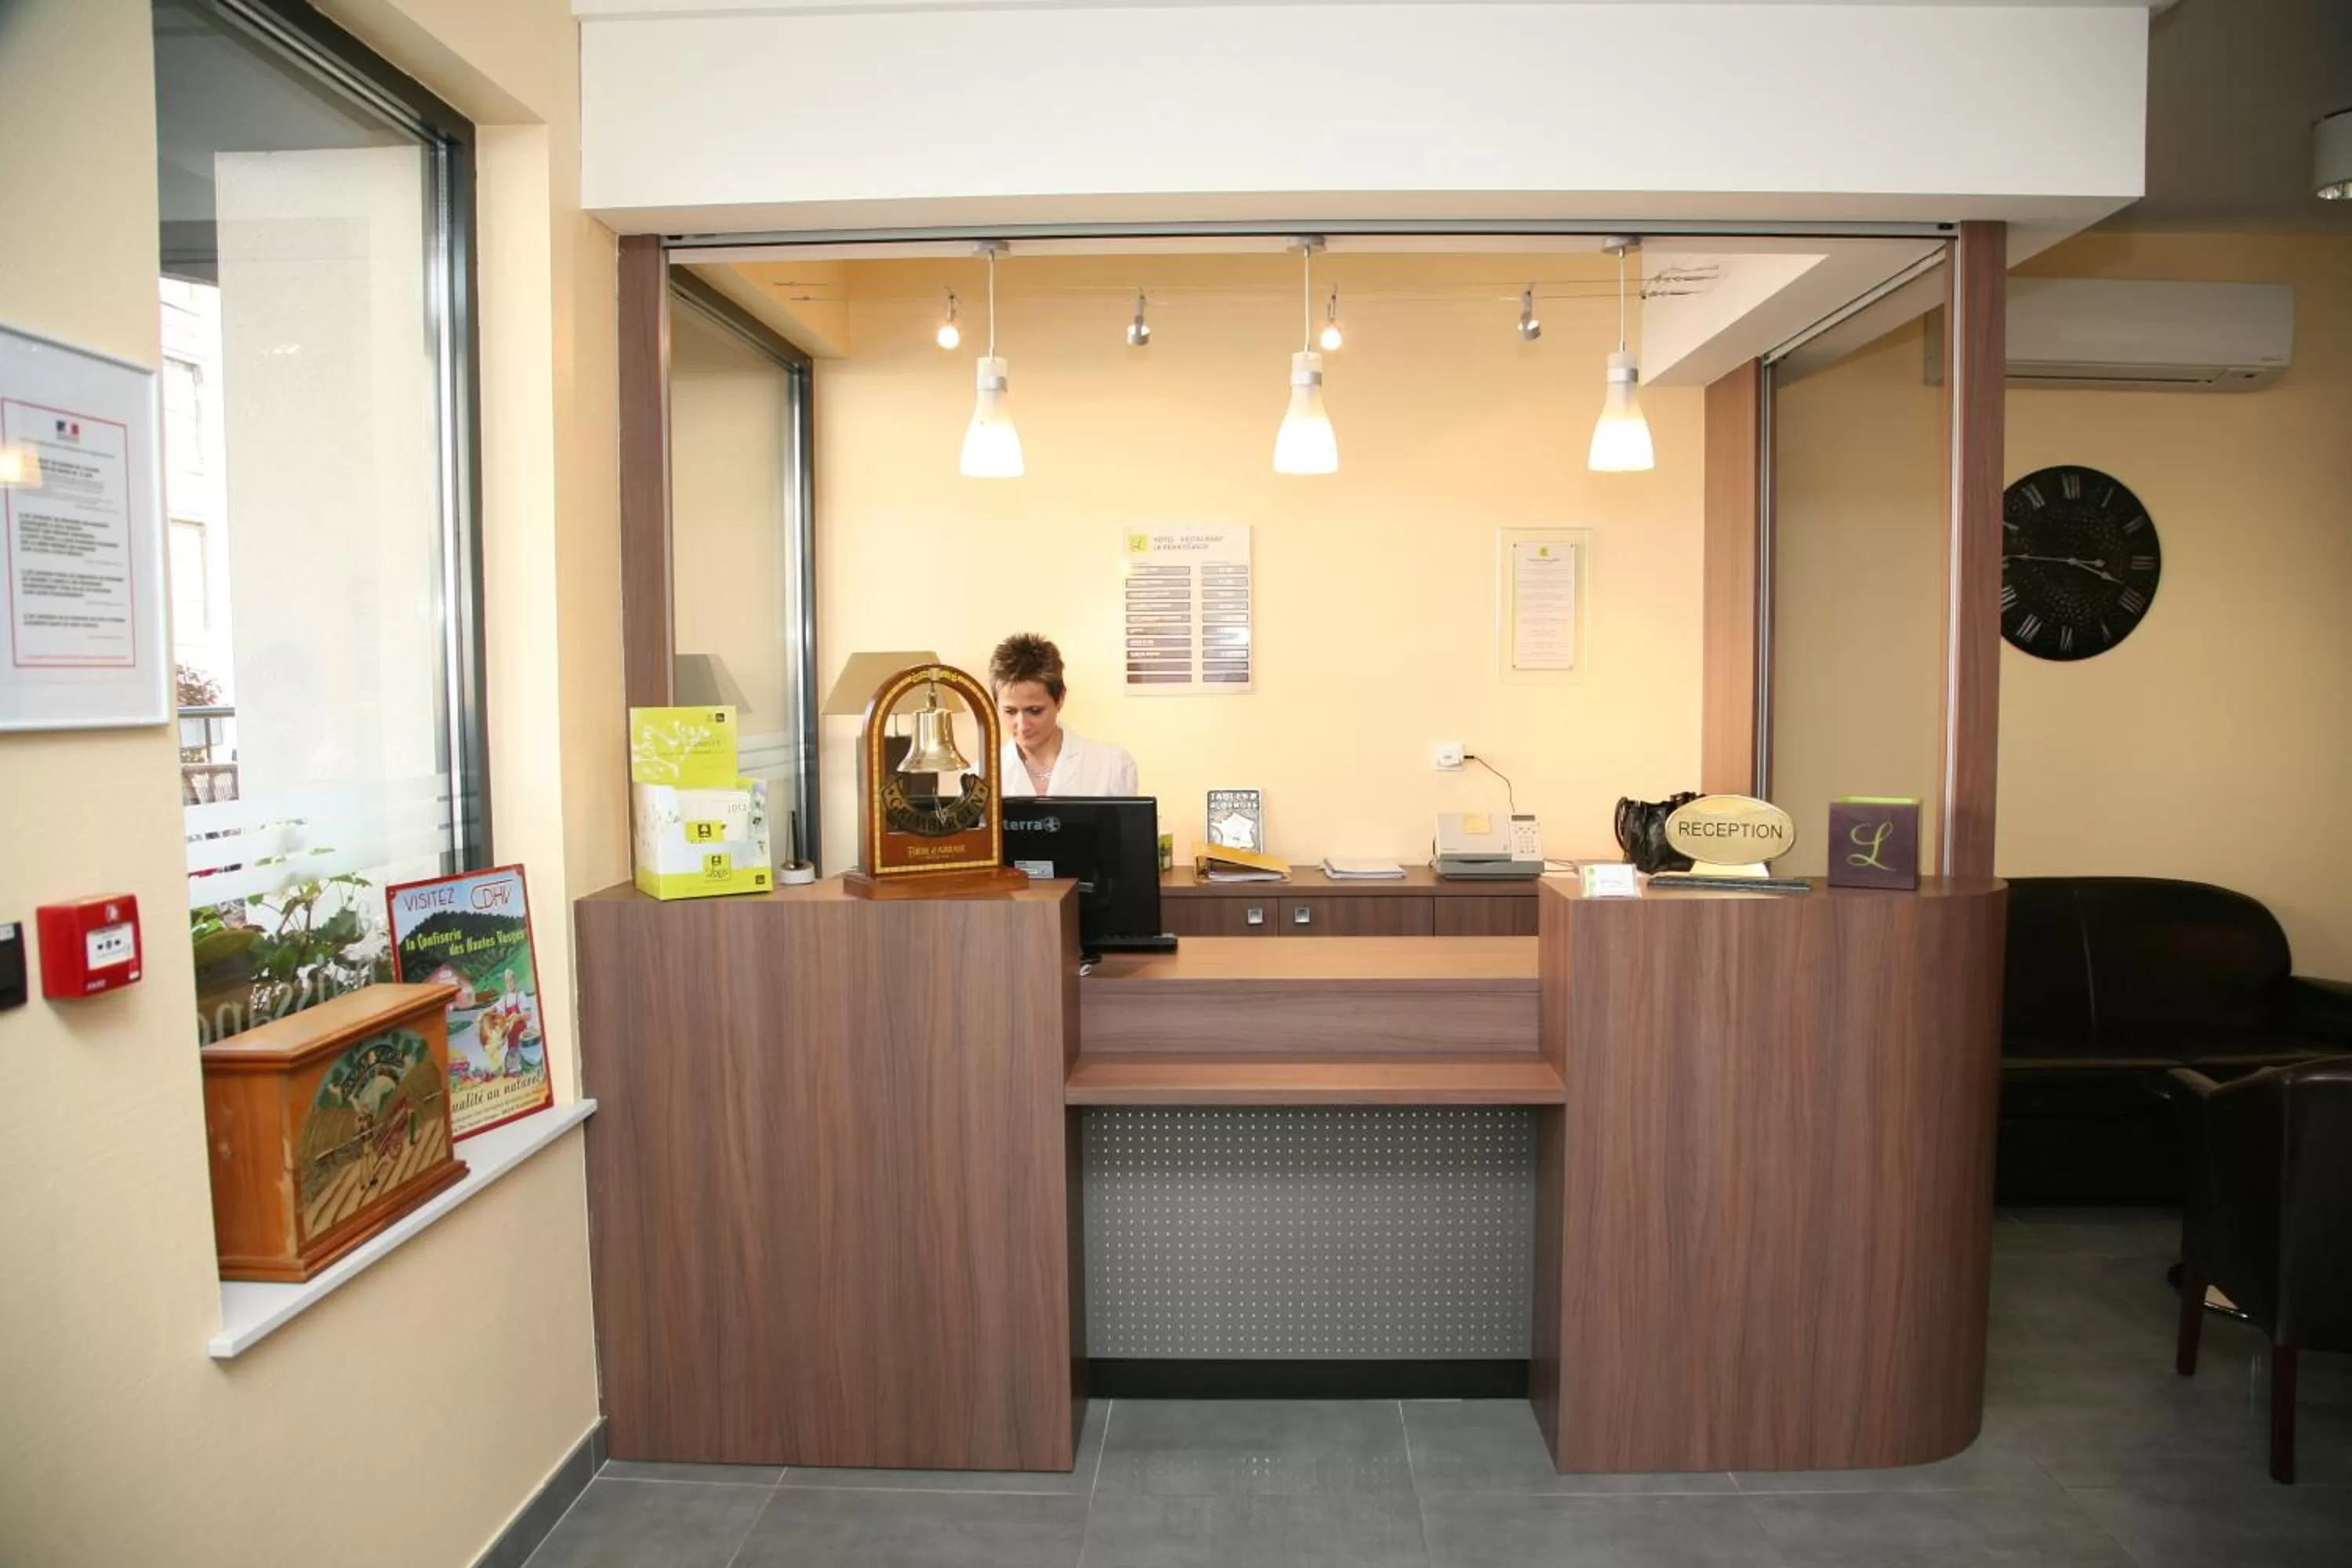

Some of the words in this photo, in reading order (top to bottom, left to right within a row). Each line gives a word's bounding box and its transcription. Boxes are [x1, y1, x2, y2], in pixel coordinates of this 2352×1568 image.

[1004, 819, 1044, 831] terra
[1679, 821, 1783, 840] RECEPTION
[403, 887, 456, 912] VISITEZ
[417, 928, 463, 951] Confiserie
